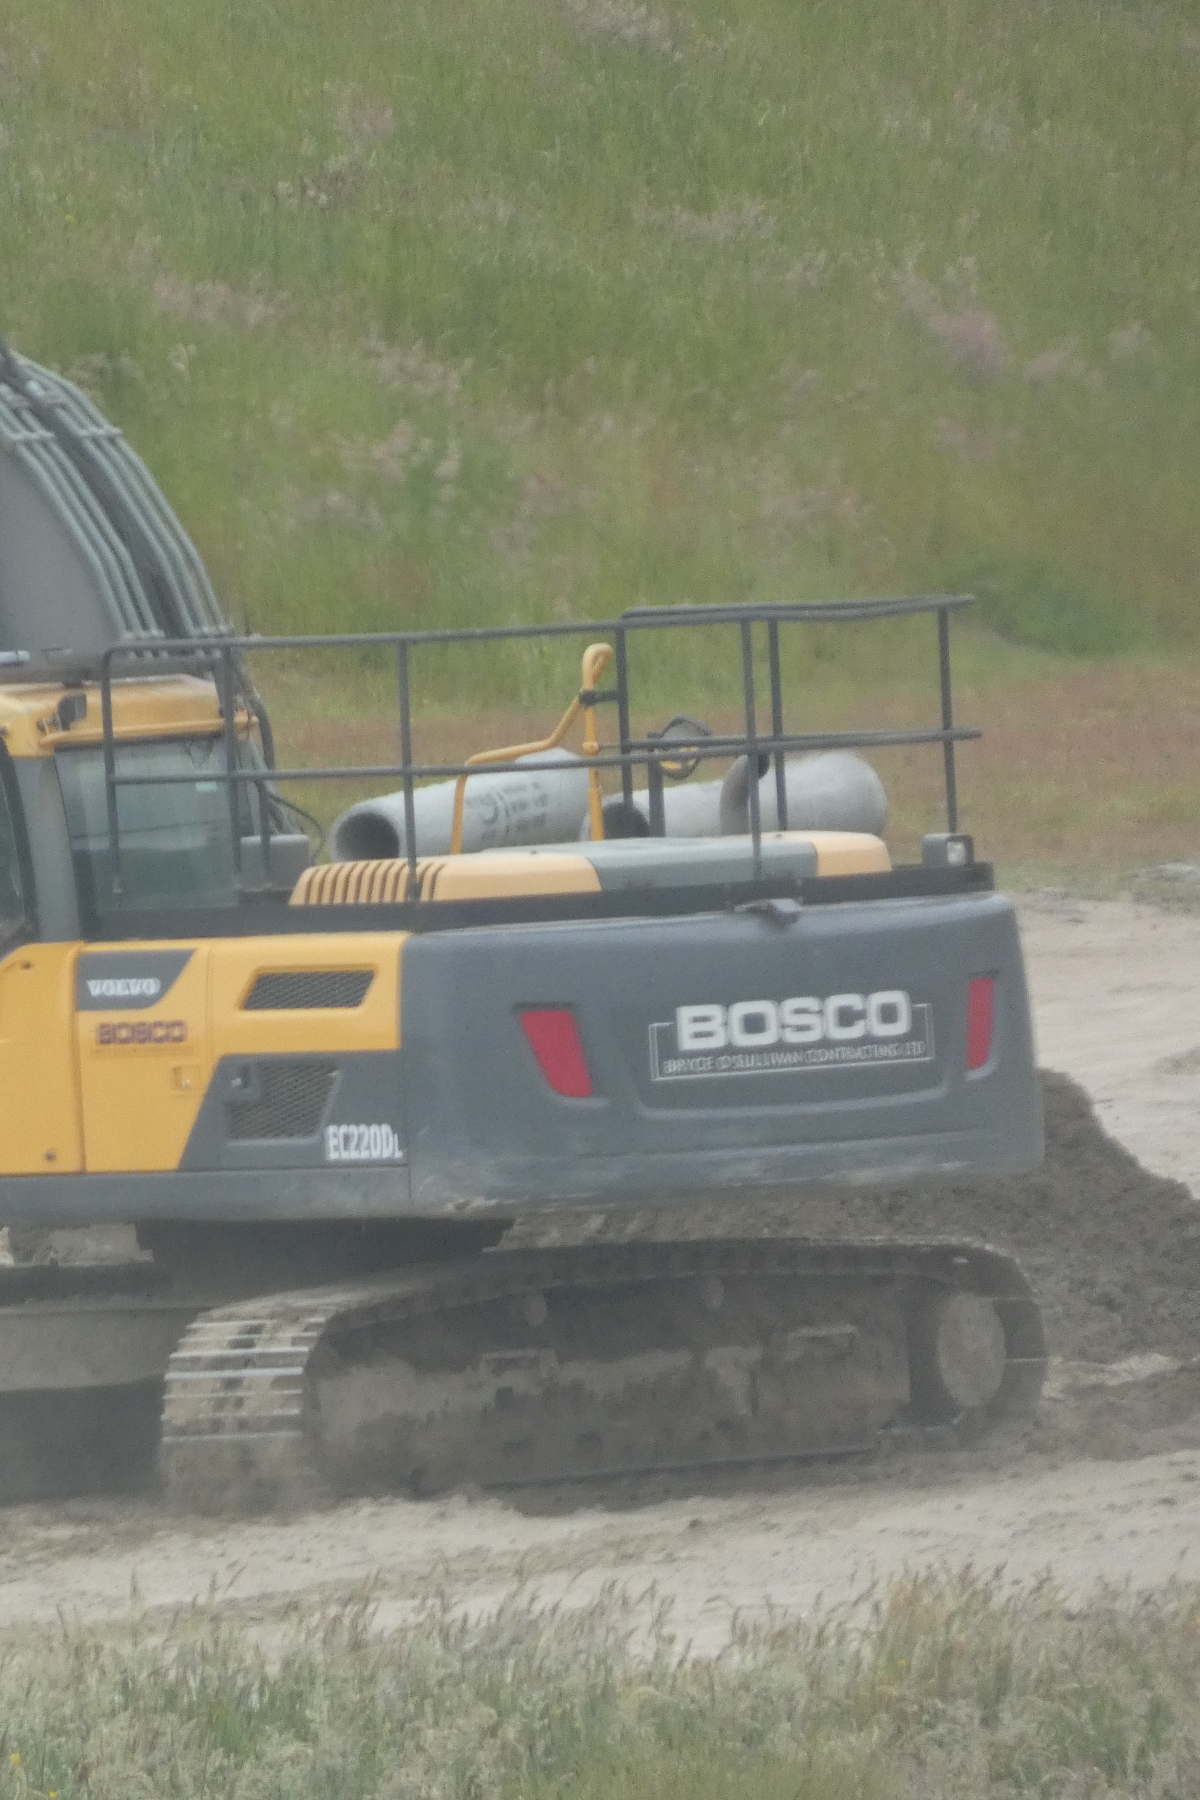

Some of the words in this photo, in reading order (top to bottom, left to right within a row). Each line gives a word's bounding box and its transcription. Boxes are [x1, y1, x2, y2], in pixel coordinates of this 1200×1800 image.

[86, 977, 162, 997] VOLVO
[96, 1020, 187, 1044] BOSCO
[676, 990, 912, 1051] BOSCO
